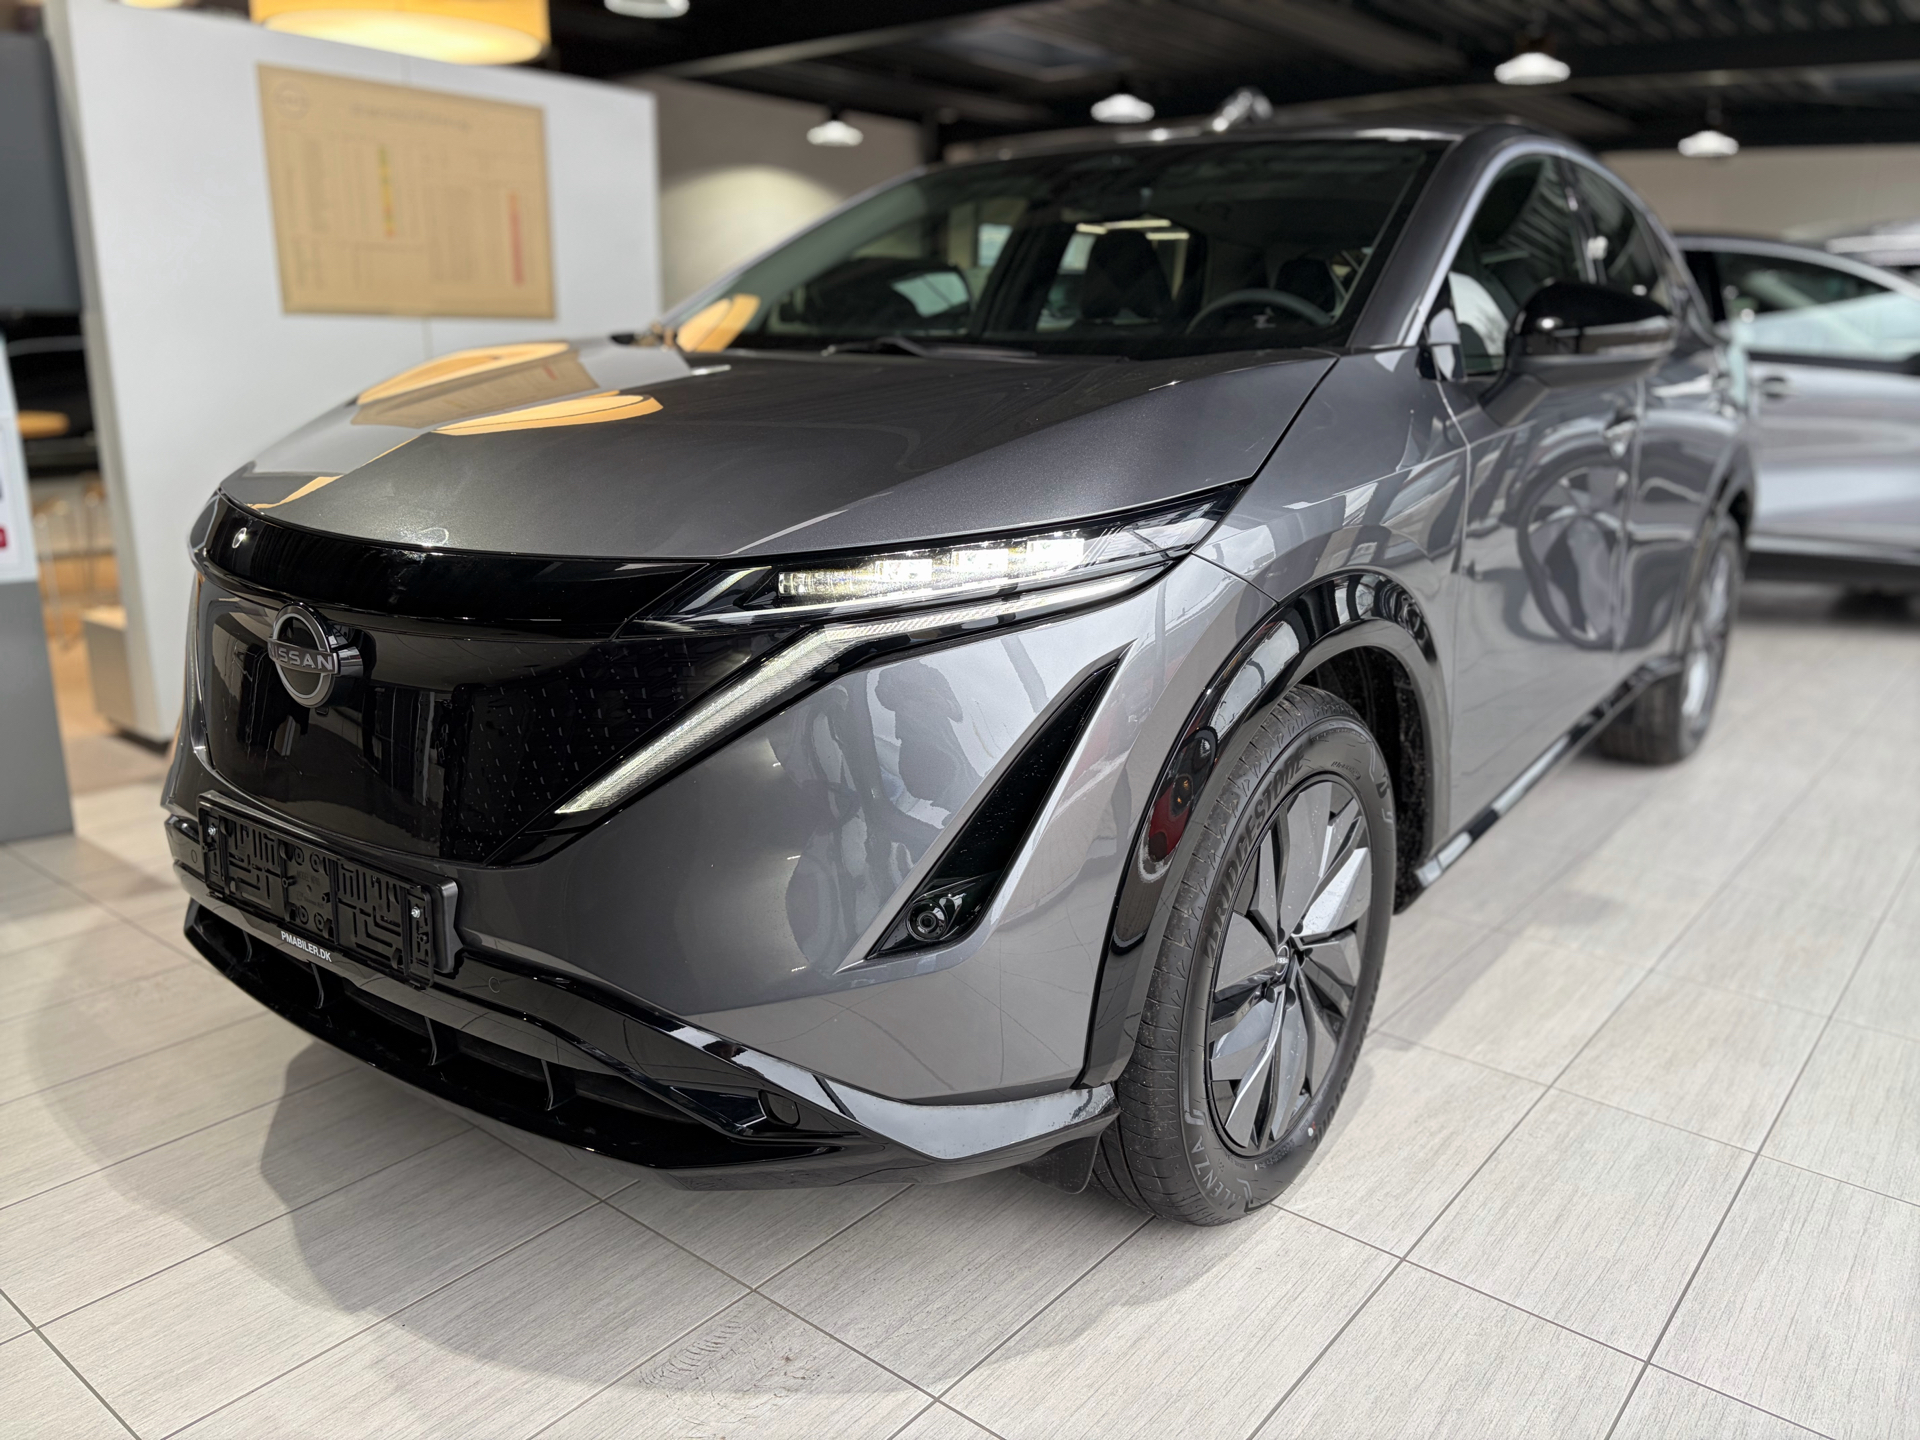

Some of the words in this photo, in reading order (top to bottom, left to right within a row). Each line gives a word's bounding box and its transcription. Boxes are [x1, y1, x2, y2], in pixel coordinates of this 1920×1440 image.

[270, 644, 333, 670] NISSAN
[1203, 746, 1305, 959] BRIDGESTONE
[280, 930, 332, 963] PMABILER.DK
[1191, 1136, 1241, 1210] ALENZA
